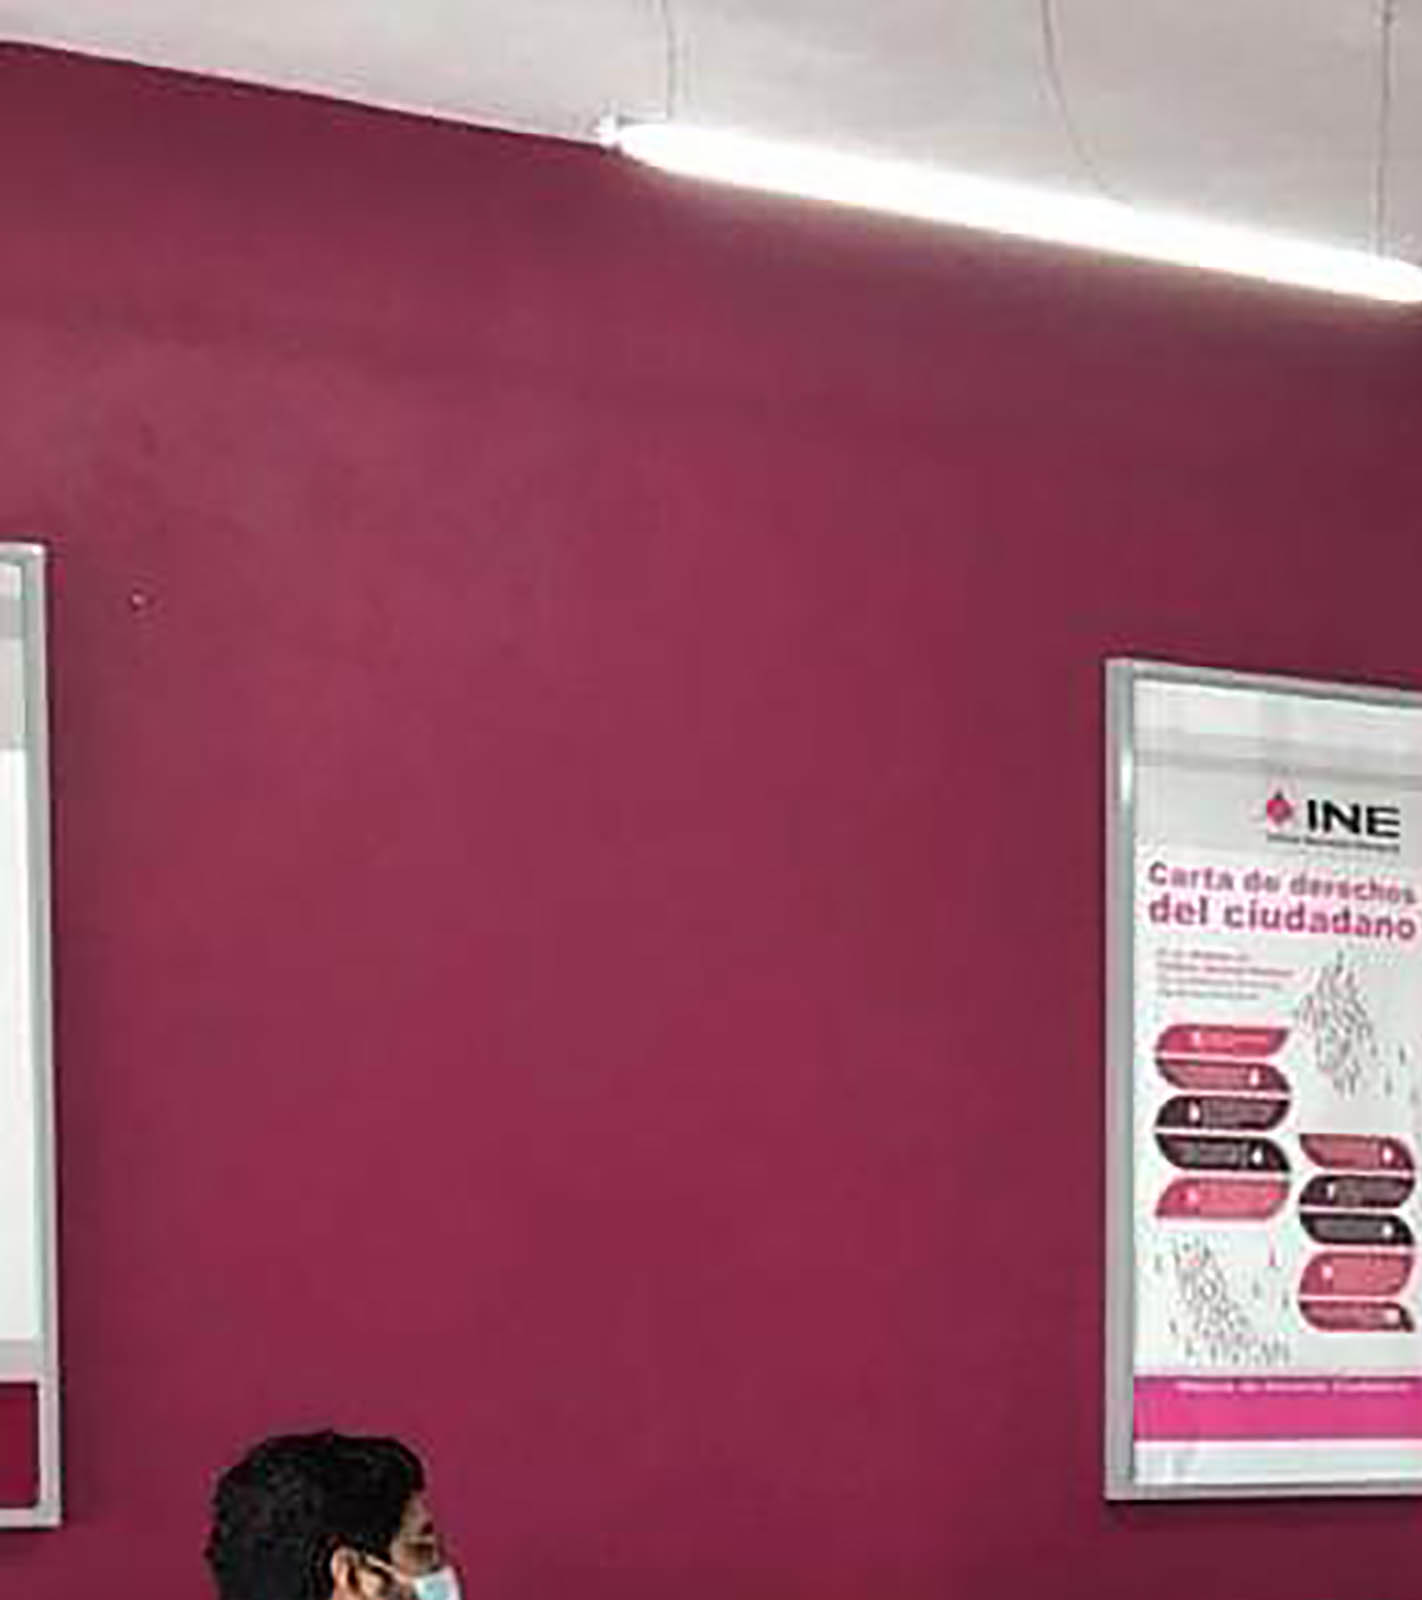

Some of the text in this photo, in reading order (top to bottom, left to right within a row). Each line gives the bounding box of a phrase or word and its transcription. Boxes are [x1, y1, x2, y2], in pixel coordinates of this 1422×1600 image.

[1307, 799, 1400, 838] INE
[1148, 861, 1417, 905] Carta de derechos
[1148, 892, 1418, 941] del ciudadano
